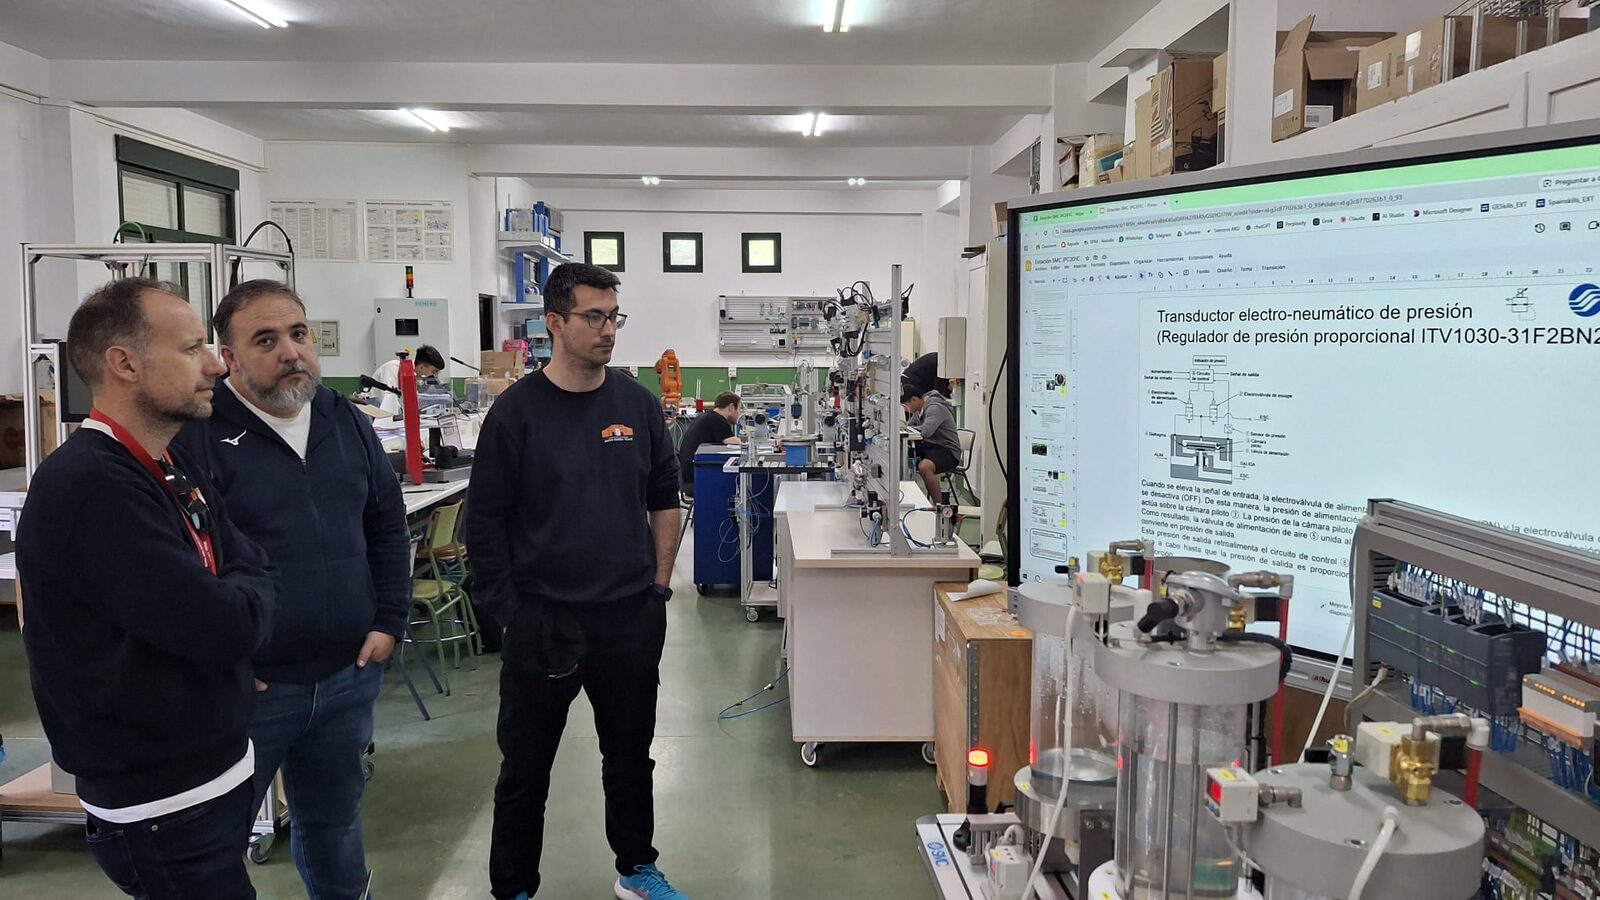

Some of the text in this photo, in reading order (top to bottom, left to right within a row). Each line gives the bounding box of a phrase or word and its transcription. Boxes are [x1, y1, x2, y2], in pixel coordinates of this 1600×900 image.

[1157, 302, 1473, 324] Transductor electro-neumático de presión
[1156, 329, 1229, 346] (Regulador
[1233, 330, 1250, 344] de
[1255, 328, 1309, 346] presión
[1314, 328, 1416, 346] proporcional
[1141, 479, 1166, 488] Cuando
[1176, 484, 1193, 492] eleva
[1202, 486, 1220, 496] señal
[1232, 490, 1260, 500] entrada,
[1272, 495, 1322, 508] electroválvula
[1324, 502, 1334, 510] de
[1512, 524, 1520, 533] la
[1523, 526, 1594, 542] electroválvula
[1141, 499, 1158, 507] actúa
[1160, 501, 1177, 510] sobre
[1186, 505, 1210, 514] cámara
[1211, 509, 1229, 518] piloto
[1254, 514, 1280, 524] presión
[1302, 520, 1330, 531] cámara
[1332, 525, 1353, 534] piloto
[1150, 490, 1180, 500] desactiva
[1233, 501, 1261, 512] manera,
[1272, 506, 1300, 516] presión
[1141, 508, 1159, 517] Como
[1201, 517, 1224, 526] válvula
[1236, 522, 1280, 534] alimentación
[1294, 531, 1308, 539] aire
[1320, 534, 1342, 544] unida
[1141, 519, 1168, 528] convierte
[1180, 524, 1203, 533] presión
[1141, 527, 1154, 535] Esta
[1156, 530, 1180, 539] presión
[1192, 535, 1212, 545] salida
[1214, 539, 1258, 552] retroalimenta
[1270, 548, 1296, 558] circuito
[1311, 556, 1338, 564] control
[1165, 541, 1181, 550] cabo
[1184, 544, 1201, 553] hasta
[1230, 552, 1255, 562] presión
[1272, 559, 1294, 569] salida
